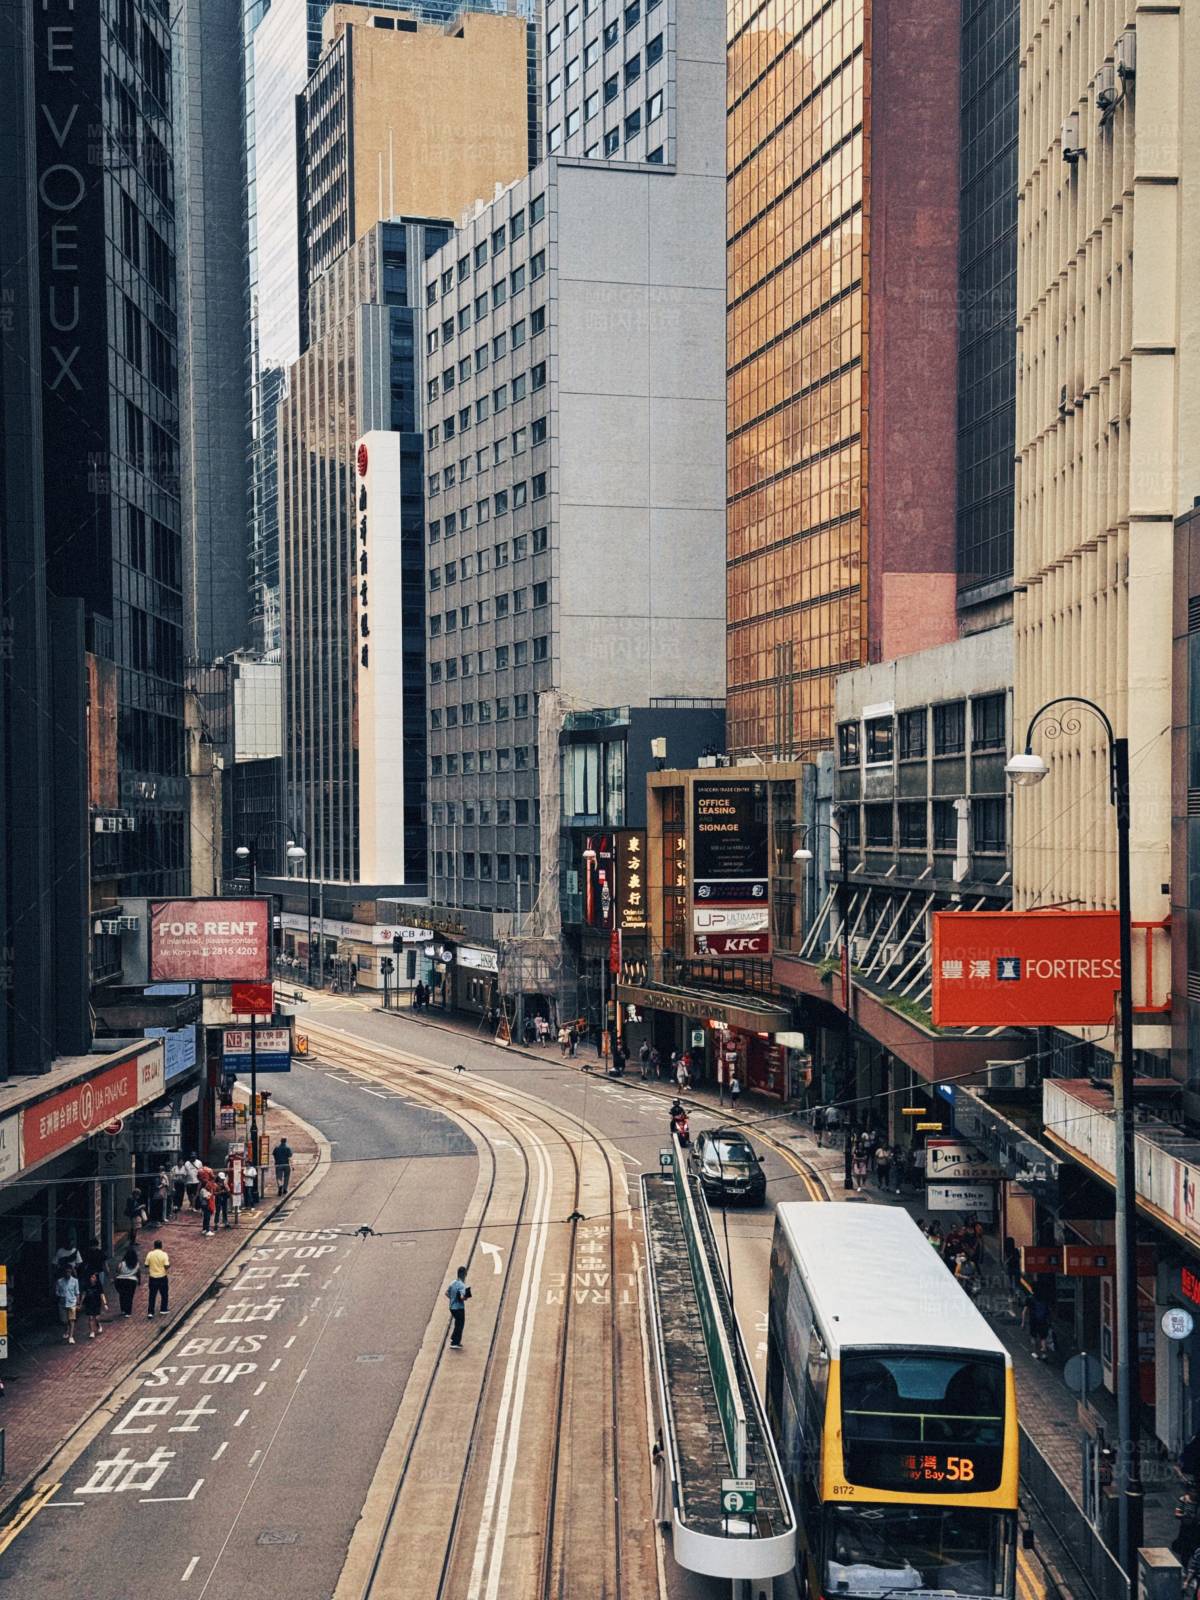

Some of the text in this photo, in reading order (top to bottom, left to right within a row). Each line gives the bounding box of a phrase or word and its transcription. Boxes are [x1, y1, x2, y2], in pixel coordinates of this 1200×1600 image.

[698, 799, 730, 807] OFFICE
[698, 807, 736, 815] LEASING
[698, 823, 740, 832] SIGNAGE
[627, 836, 641, 906] 東方表行
[159, 921, 258, 936] FOR RENT
[237, 947, 257, 956] 4203
[724, 938, 760, 951] KFC
[941, 960, 991, 979] 豐澤
[1025, 959, 1122, 979] FORTRESS
[227, 1033, 241, 1047] NE
[104, 1077, 128, 1105] FINANCE
[273, 1227, 343, 1242] BUS
[251, 1245, 338, 1262] STOP
[232, 1264, 312, 1291] 巴士
[549, 1272, 635, 1287] LANE
[546, 1289, 637, 1305] TRAM
[213, 1295, 287, 1325] 站
[176, 1334, 269, 1357] BUS
[143, 1363, 259, 1387] STOP
[111, 1394, 218, 1435] 巴士
[73, 1446, 178, 1494] 站
[925, 1469, 945, 1481] Bay
[946, 1457, 975, 1482] 5B
[833, 1486, 855, 1495] 8172
